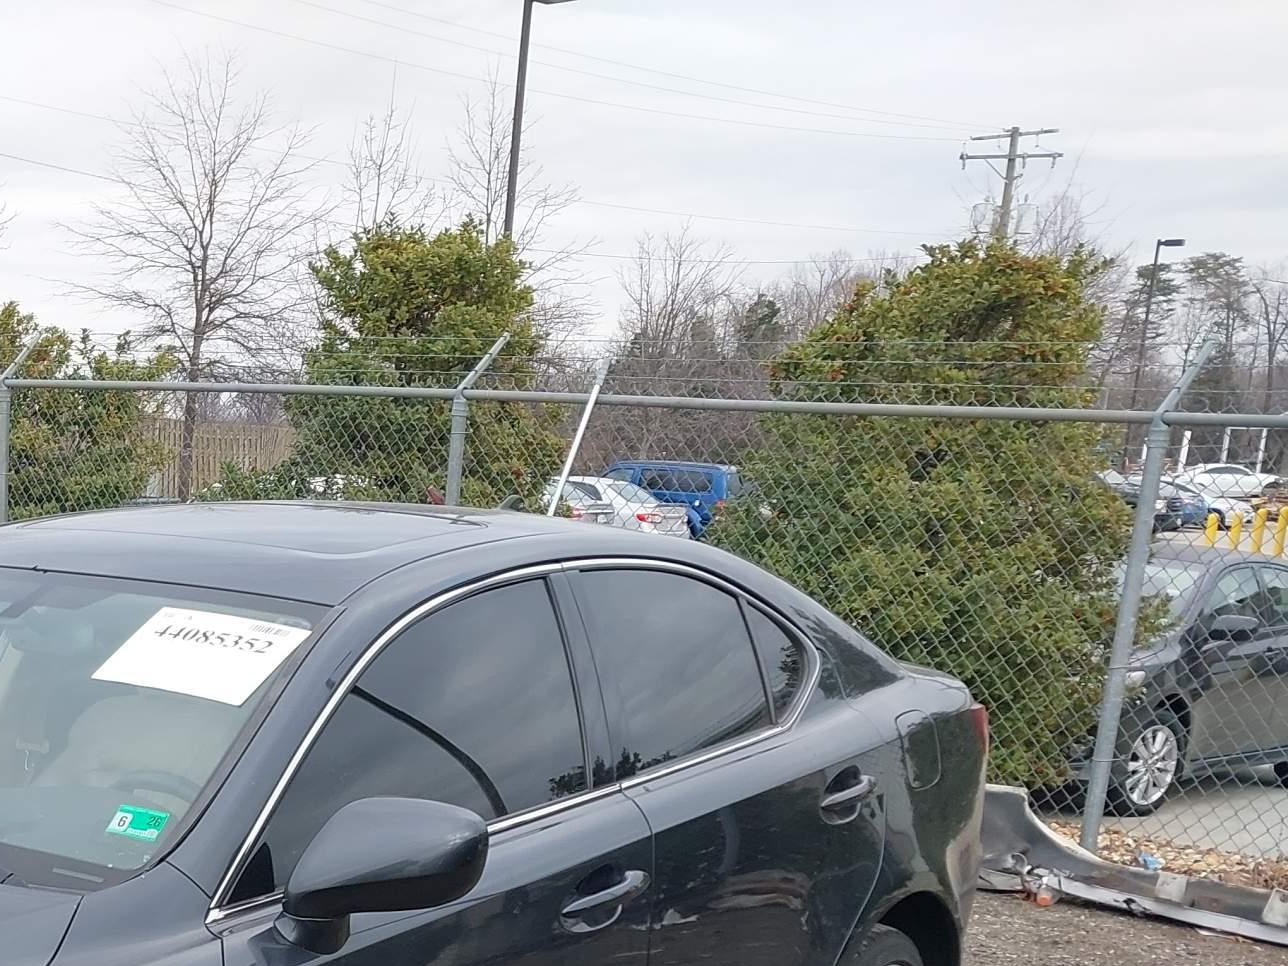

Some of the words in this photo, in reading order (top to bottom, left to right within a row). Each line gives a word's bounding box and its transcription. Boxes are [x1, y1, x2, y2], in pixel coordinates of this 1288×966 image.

[154, 624, 274, 654] 44085352
[117, 815, 128, 827] 6
[147, 815, 161, 827] 26
